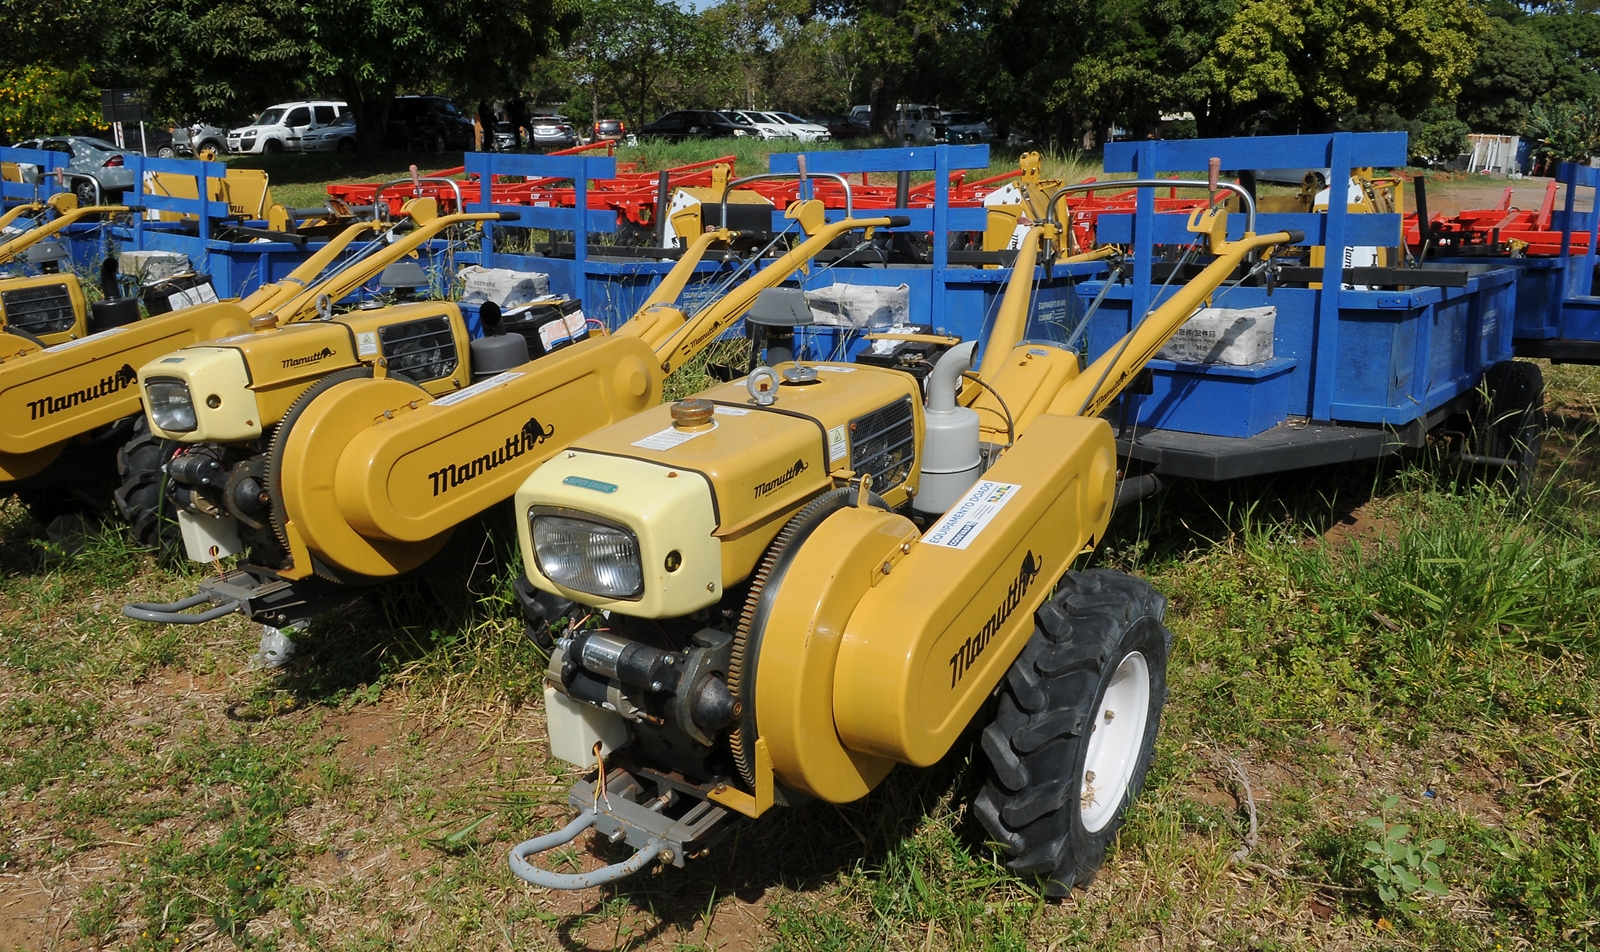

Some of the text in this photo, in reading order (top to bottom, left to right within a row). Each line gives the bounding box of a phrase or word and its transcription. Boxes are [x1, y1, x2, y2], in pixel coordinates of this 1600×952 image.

[281, 349, 326, 369] Mamutth
[26, 367, 129, 421] Mamutth
[428, 426, 536, 497] Mamutth
[754, 464, 800, 499] Mamutth
[929, 500, 975, 544] EQUIPAMENTO
[973, 482, 994, 503] DOADO
[949, 565, 1031, 690] Mamutth
